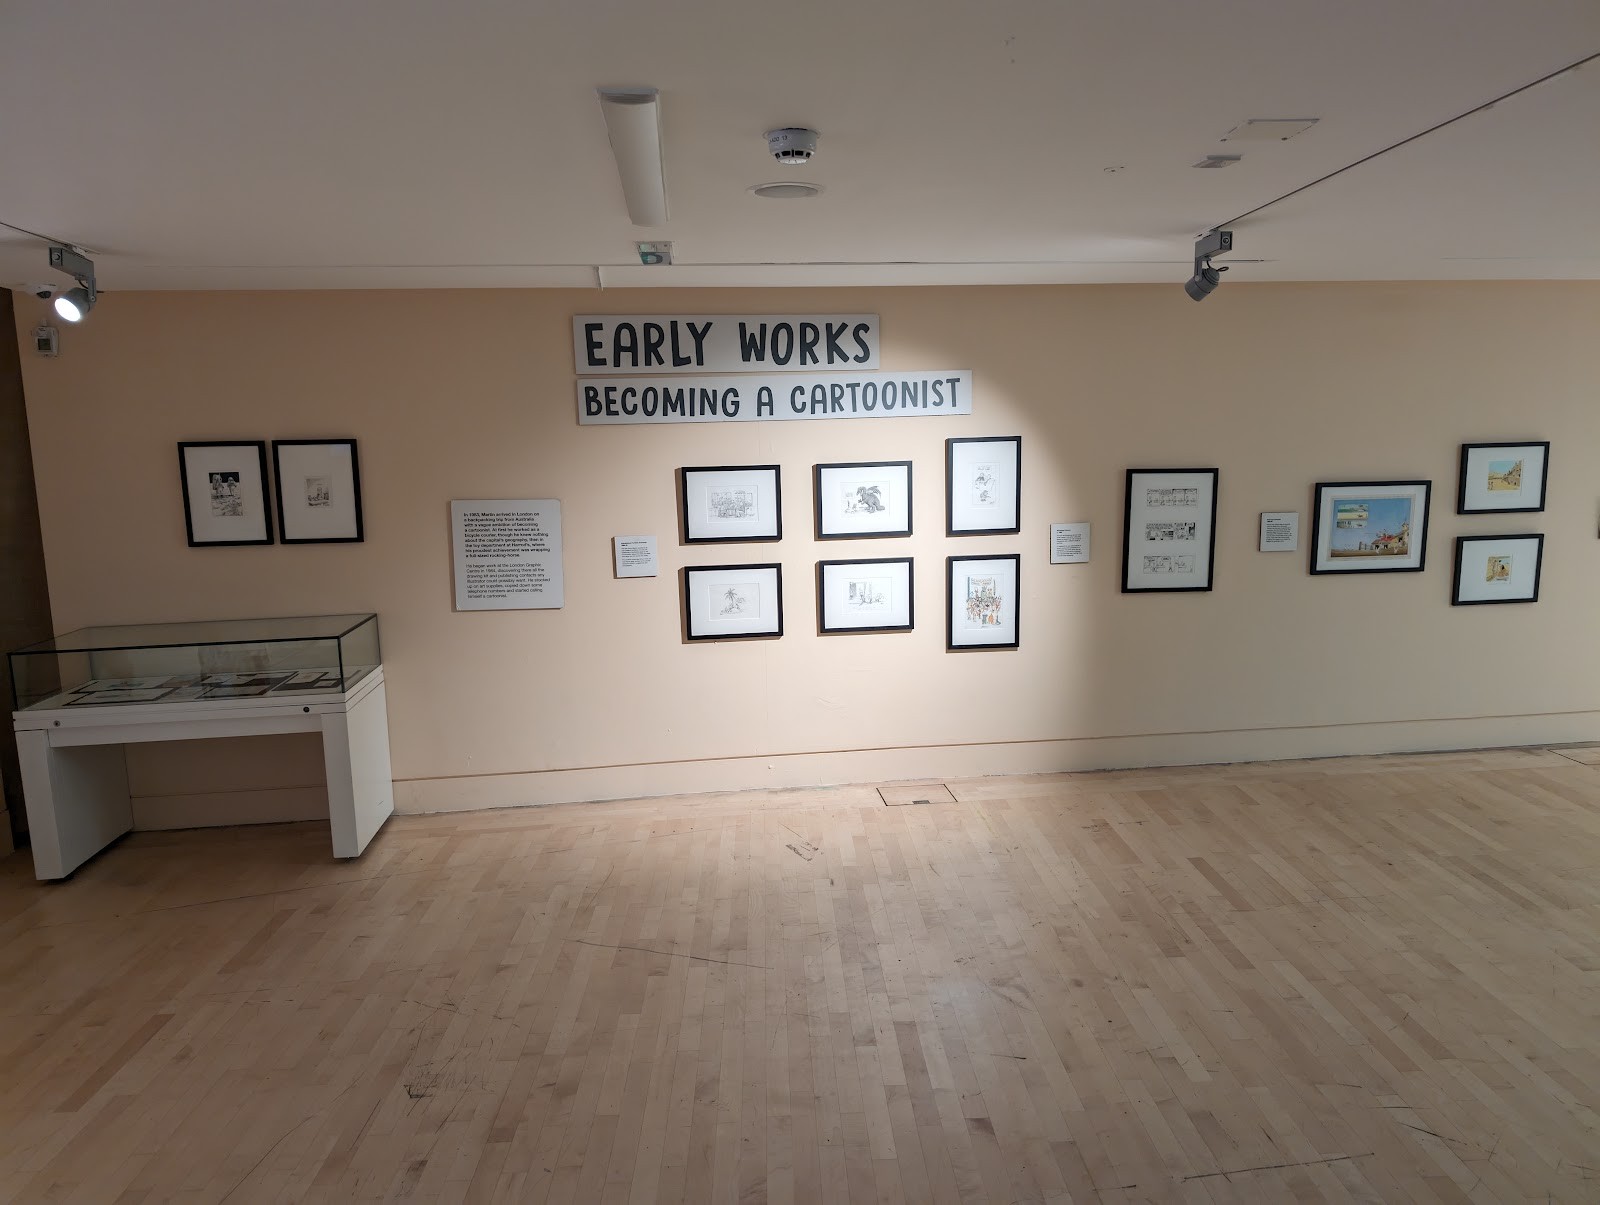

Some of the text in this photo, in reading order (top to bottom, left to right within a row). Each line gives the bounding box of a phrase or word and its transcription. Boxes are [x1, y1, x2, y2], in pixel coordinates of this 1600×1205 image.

[585, 320, 870, 367] EARLY WORKS
[584, 377, 961, 417] BECOMING A CARTOONIST
